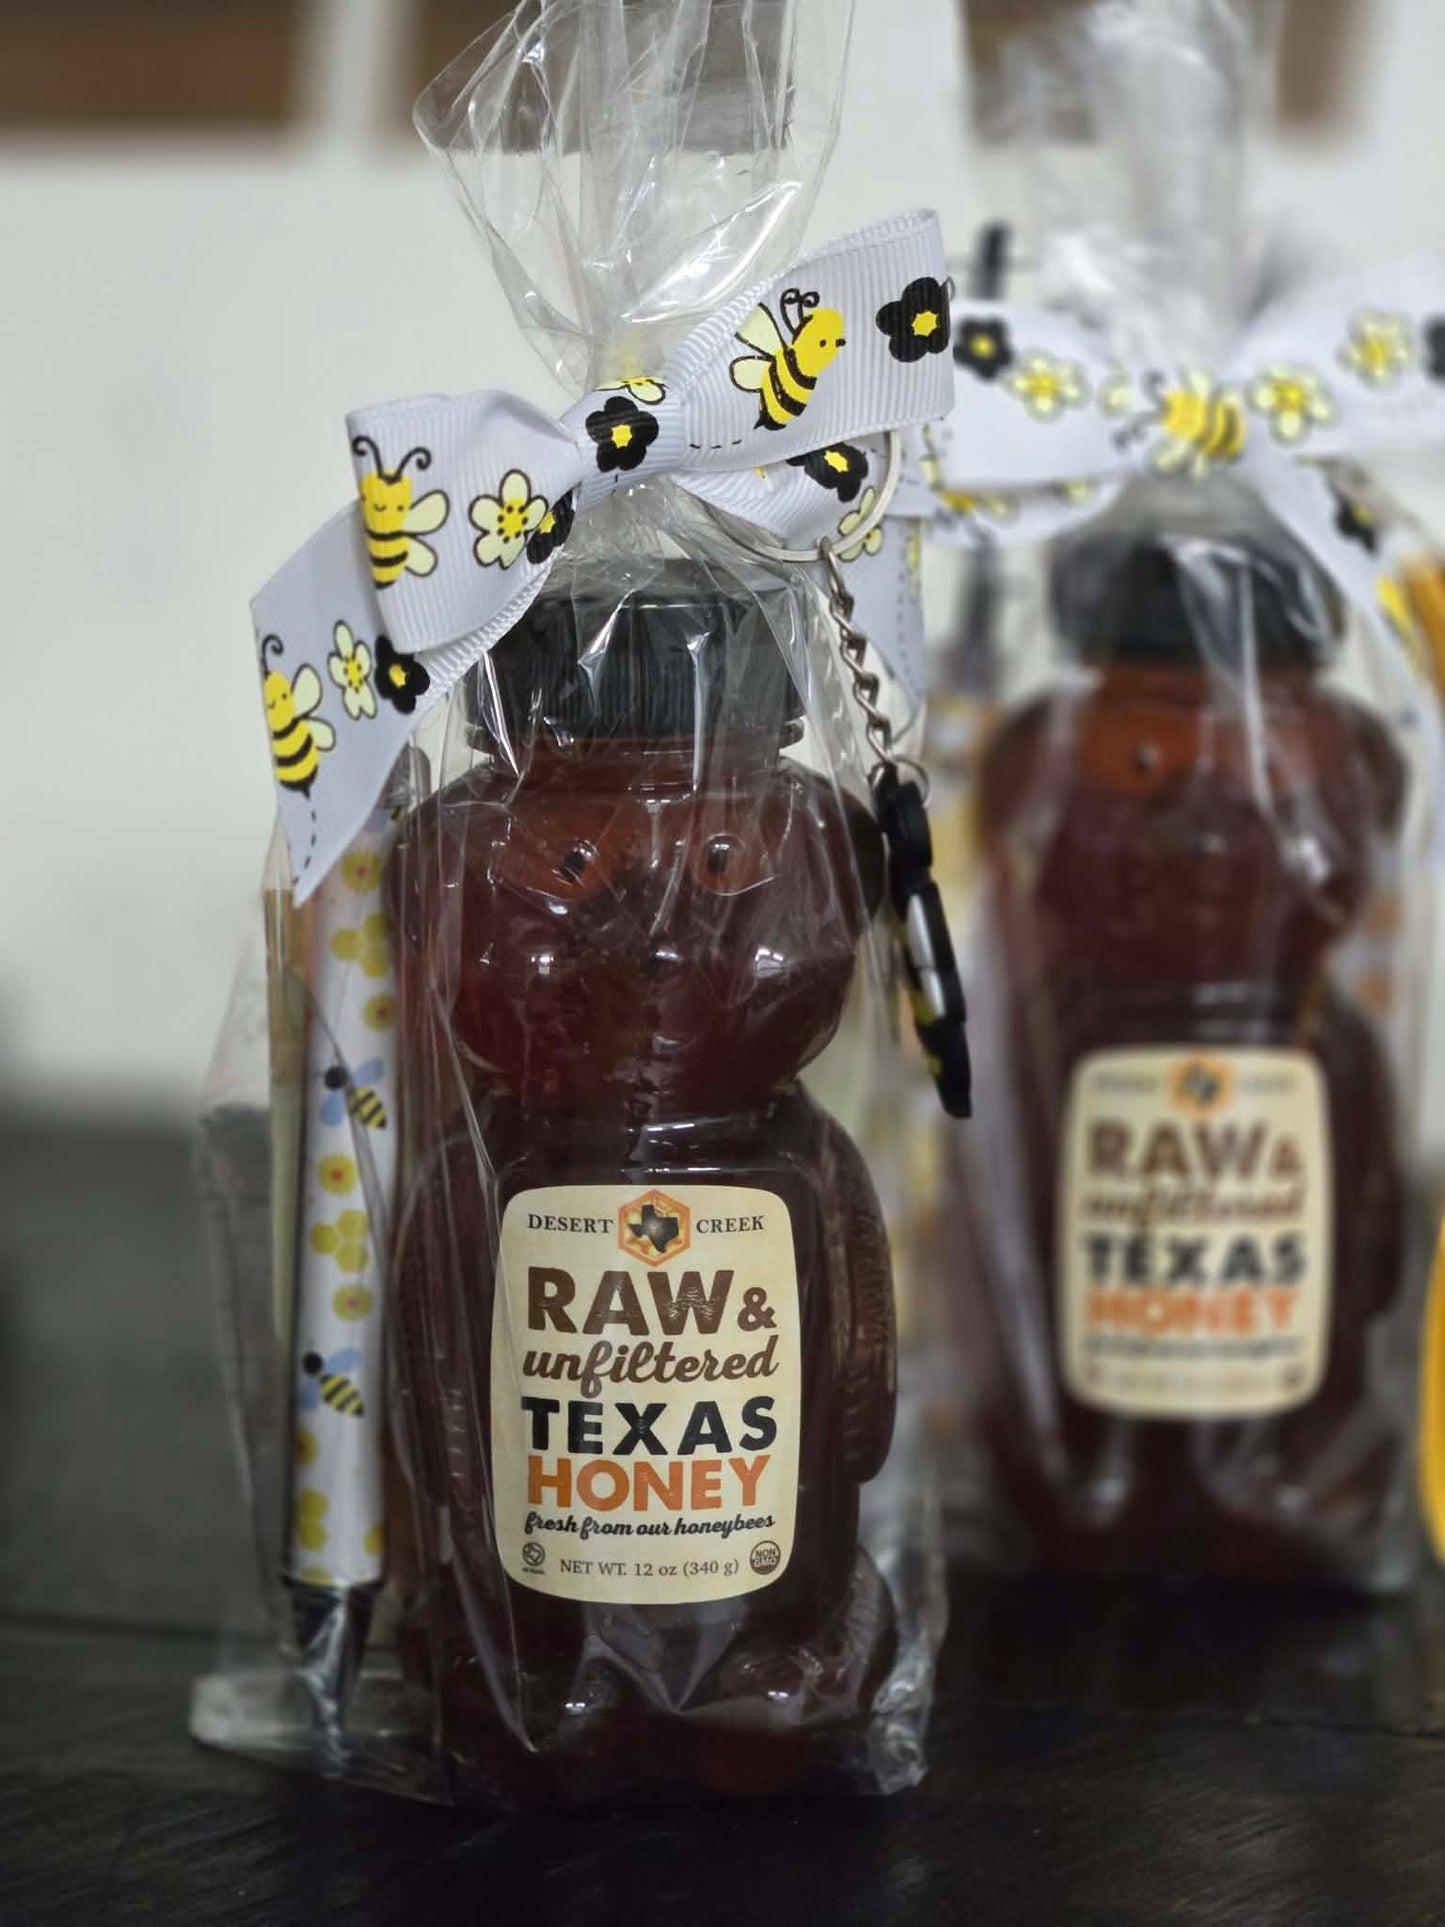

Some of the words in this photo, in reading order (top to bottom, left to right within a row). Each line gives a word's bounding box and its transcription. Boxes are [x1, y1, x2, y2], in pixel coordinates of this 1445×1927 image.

[528, 1213, 613, 1234] DESERT
[696, 1214, 766, 1234] CREEK
[1084, 1233, 1304, 1284] TEXAS
[521, 1335, 780, 1398] unfiltered
[521, 1396, 777, 1455] TEXAS
[527, 1455, 771, 1512] HONEY
[524, 1511, 578, 1534] fresh
[579, 1517, 634, 1540] from
[636, 1523, 672, 1536] our
[674, 1513, 776, 1539] honeybees
[560, 1558, 593, 1574] NET
[597, 1561, 627, 1576] WT.
[635, 1562, 654, 1576] 12
[659, 1565, 677, 1577] oz
[683, 1561, 719, 1577] (340
[723, 1558, 740, 1576] g)
[755, 1547, 776, 1559] NON
